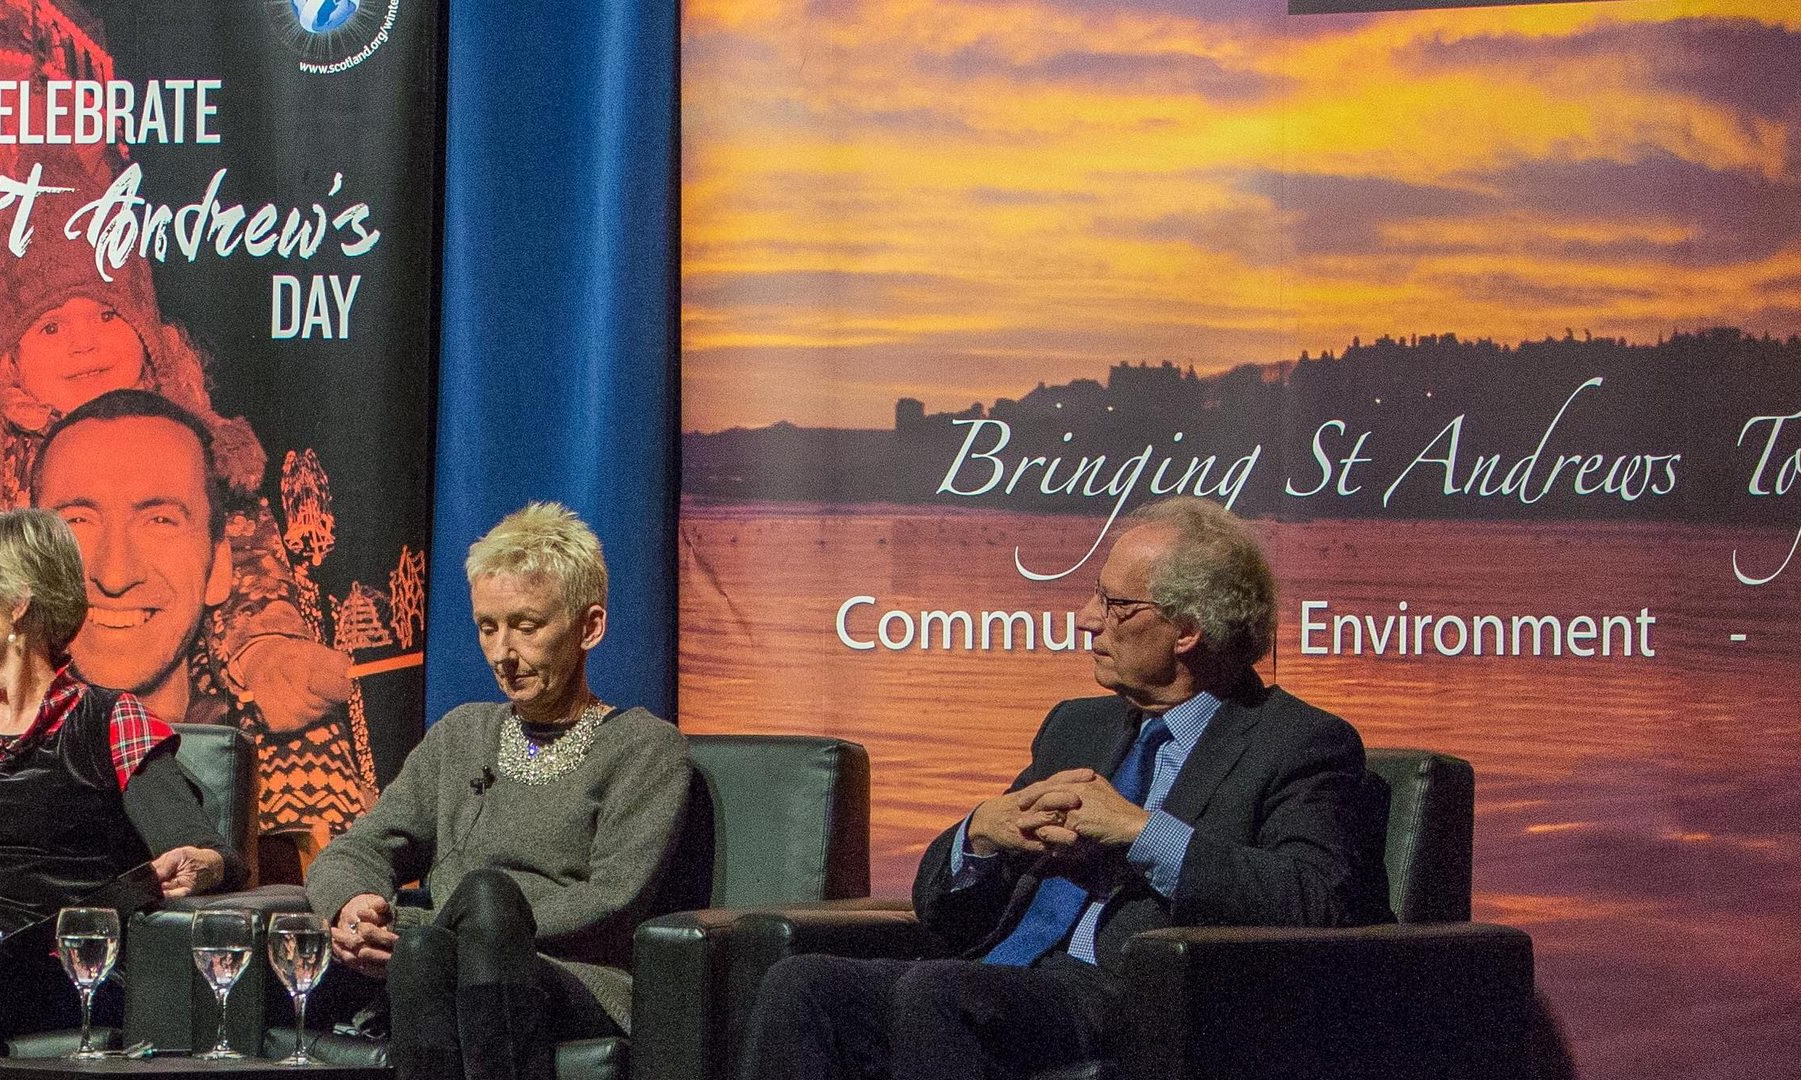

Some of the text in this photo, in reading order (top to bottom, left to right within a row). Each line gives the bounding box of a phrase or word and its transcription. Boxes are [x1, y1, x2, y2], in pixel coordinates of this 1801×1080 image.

[299, 0, 400, 74] www.scotland.org/winte
[63, 162, 381, 283] Andrew's
[270, 274, 362, 340] DAY
[936, 376, 1801, 585] Bringing St Andrews To
[836, 595, 1093, 651] Commu
[1301, 600, 1657, 658] Environment
